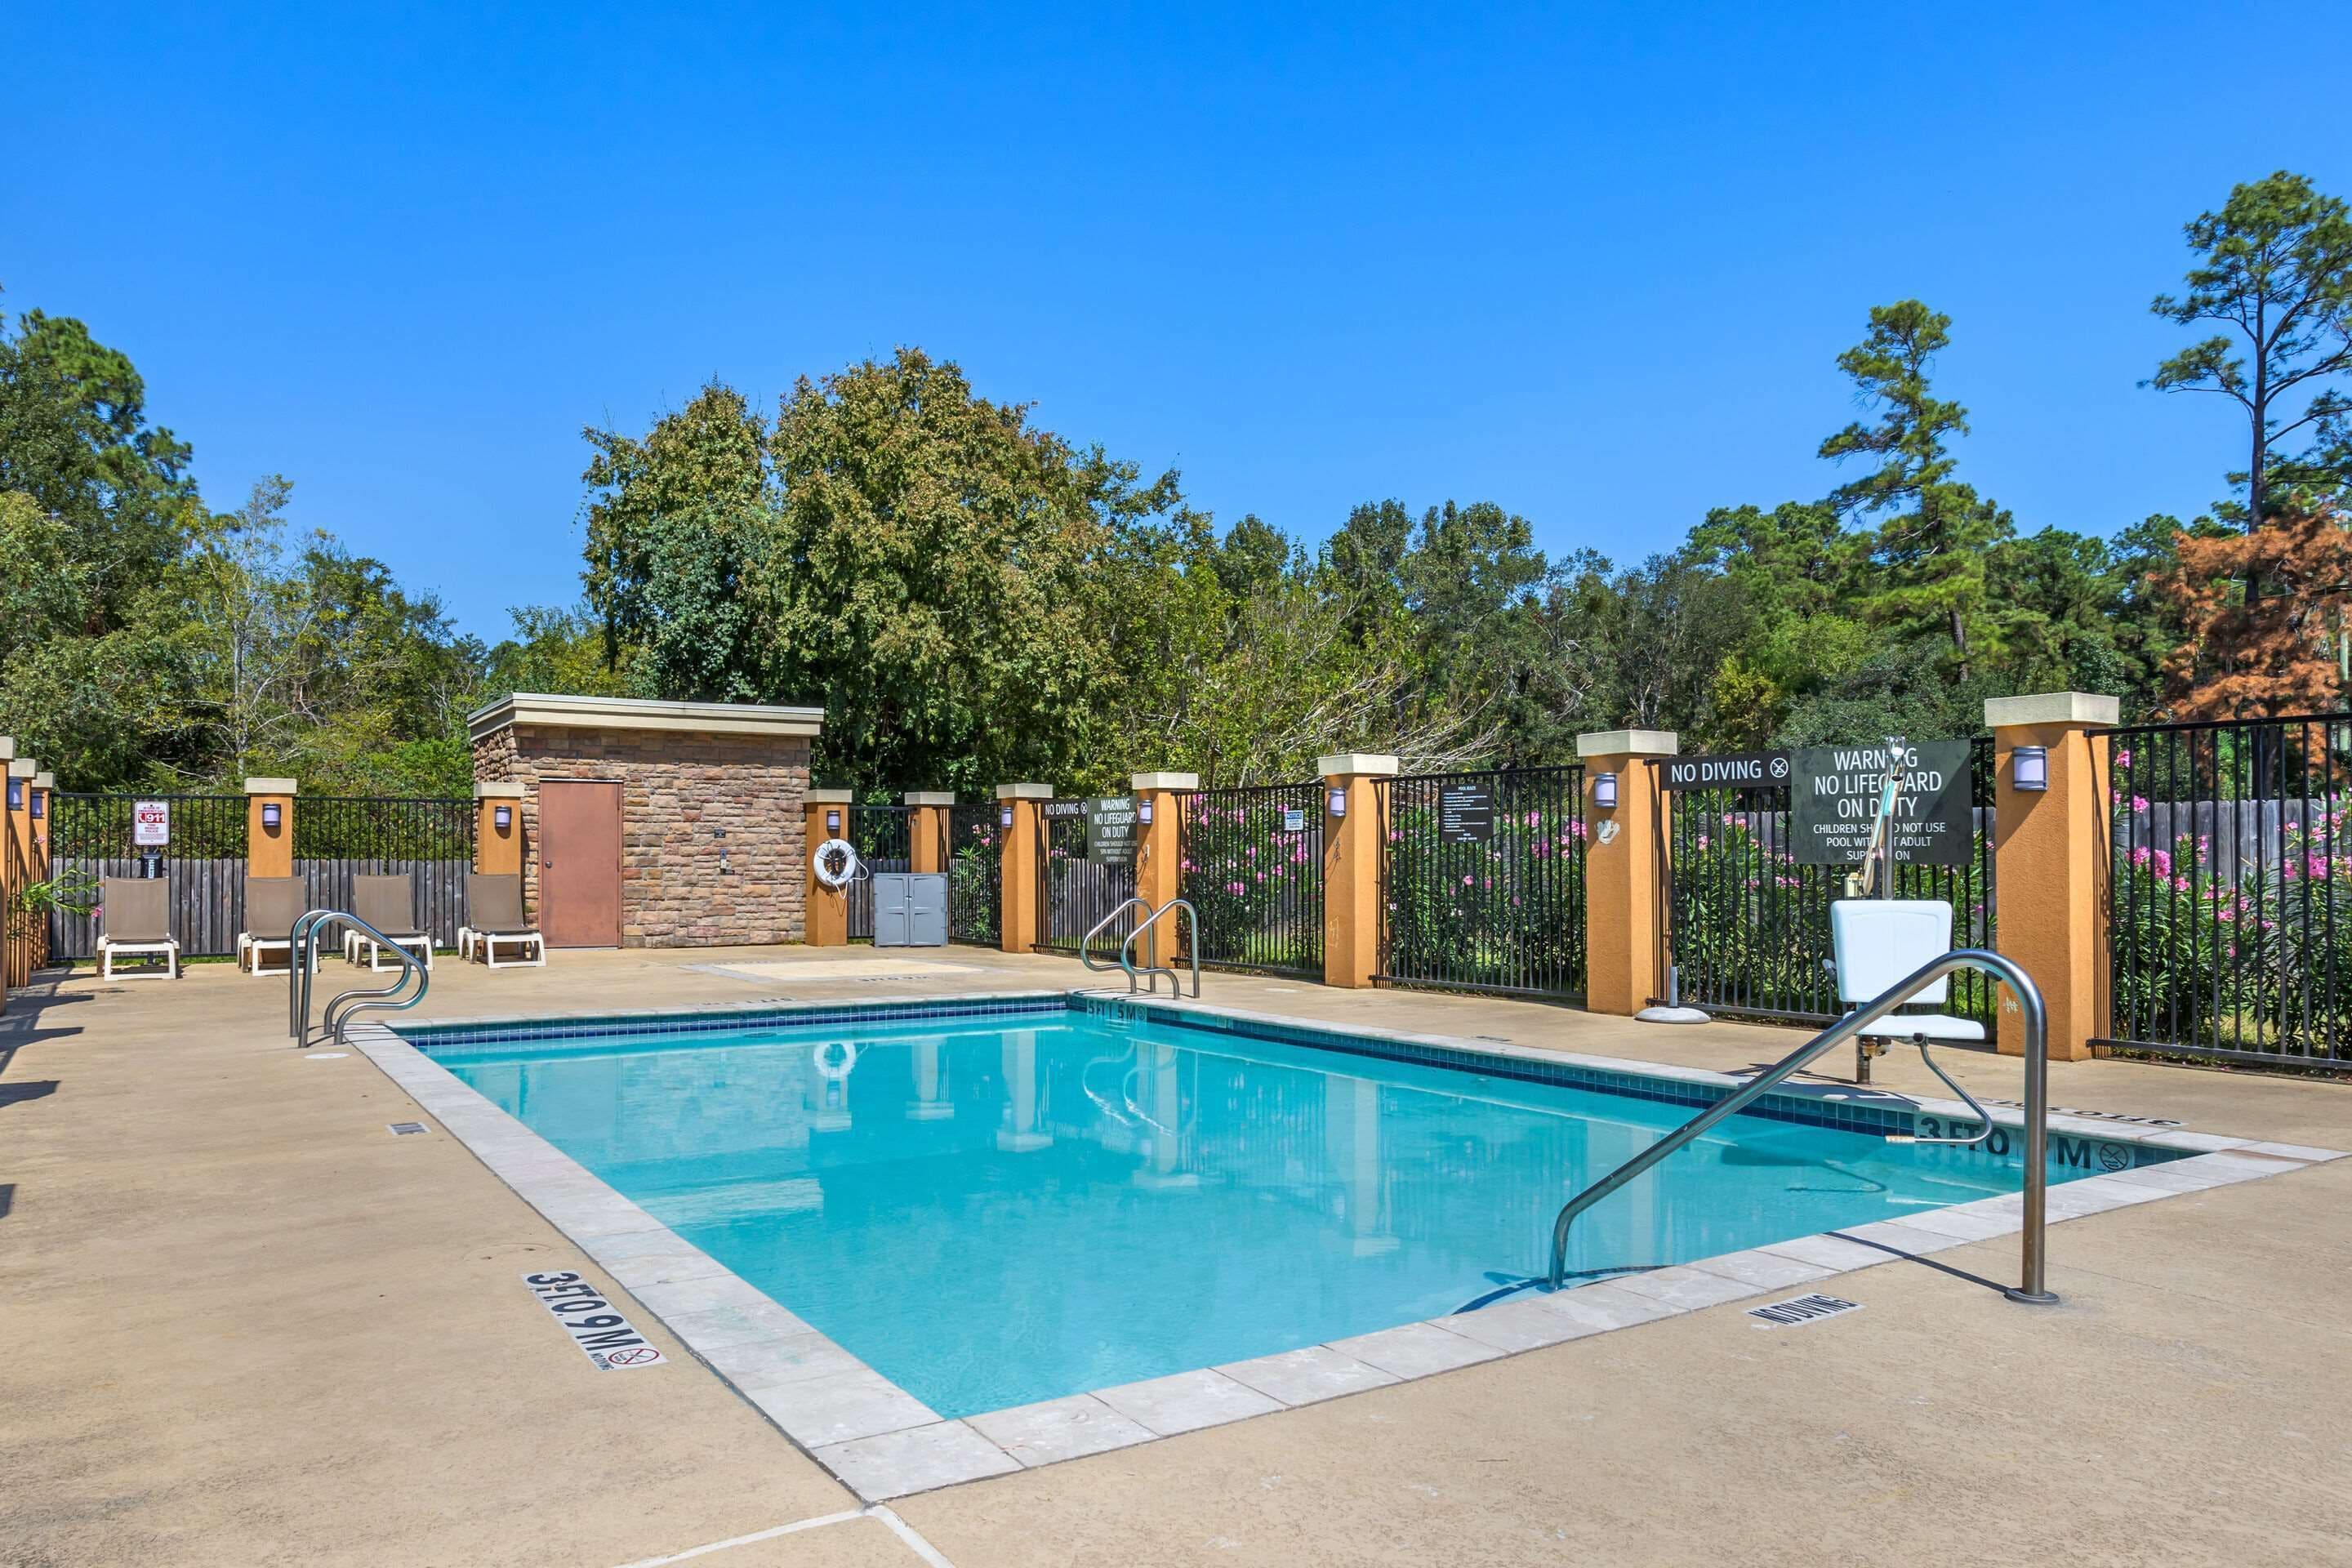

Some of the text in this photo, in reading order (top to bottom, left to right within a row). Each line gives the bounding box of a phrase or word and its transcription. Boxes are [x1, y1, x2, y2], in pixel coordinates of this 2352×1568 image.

[1833, 747, 1918, 771] WARNG
[1672, 760, 1762, 782] NO DIVING
[1815, 771, 1942, 795] NO LIFEARD
[1045, 804, 1078, 816] NO DIVING
[1101, 799, 1129, 811] WARNING
[1838, 797, 1918, 817] ON DTY
[146, 813, 165, 822] 911
[1094, 812, 1137, 825] NO LIFEGUARD
[1102, 826, 1129, 838] ON DUTY
[1813, 822, 1946, 834] CHILDREN SHD NOT USE
[1826, 836, 1932, 847] POOL WITT ADULT
